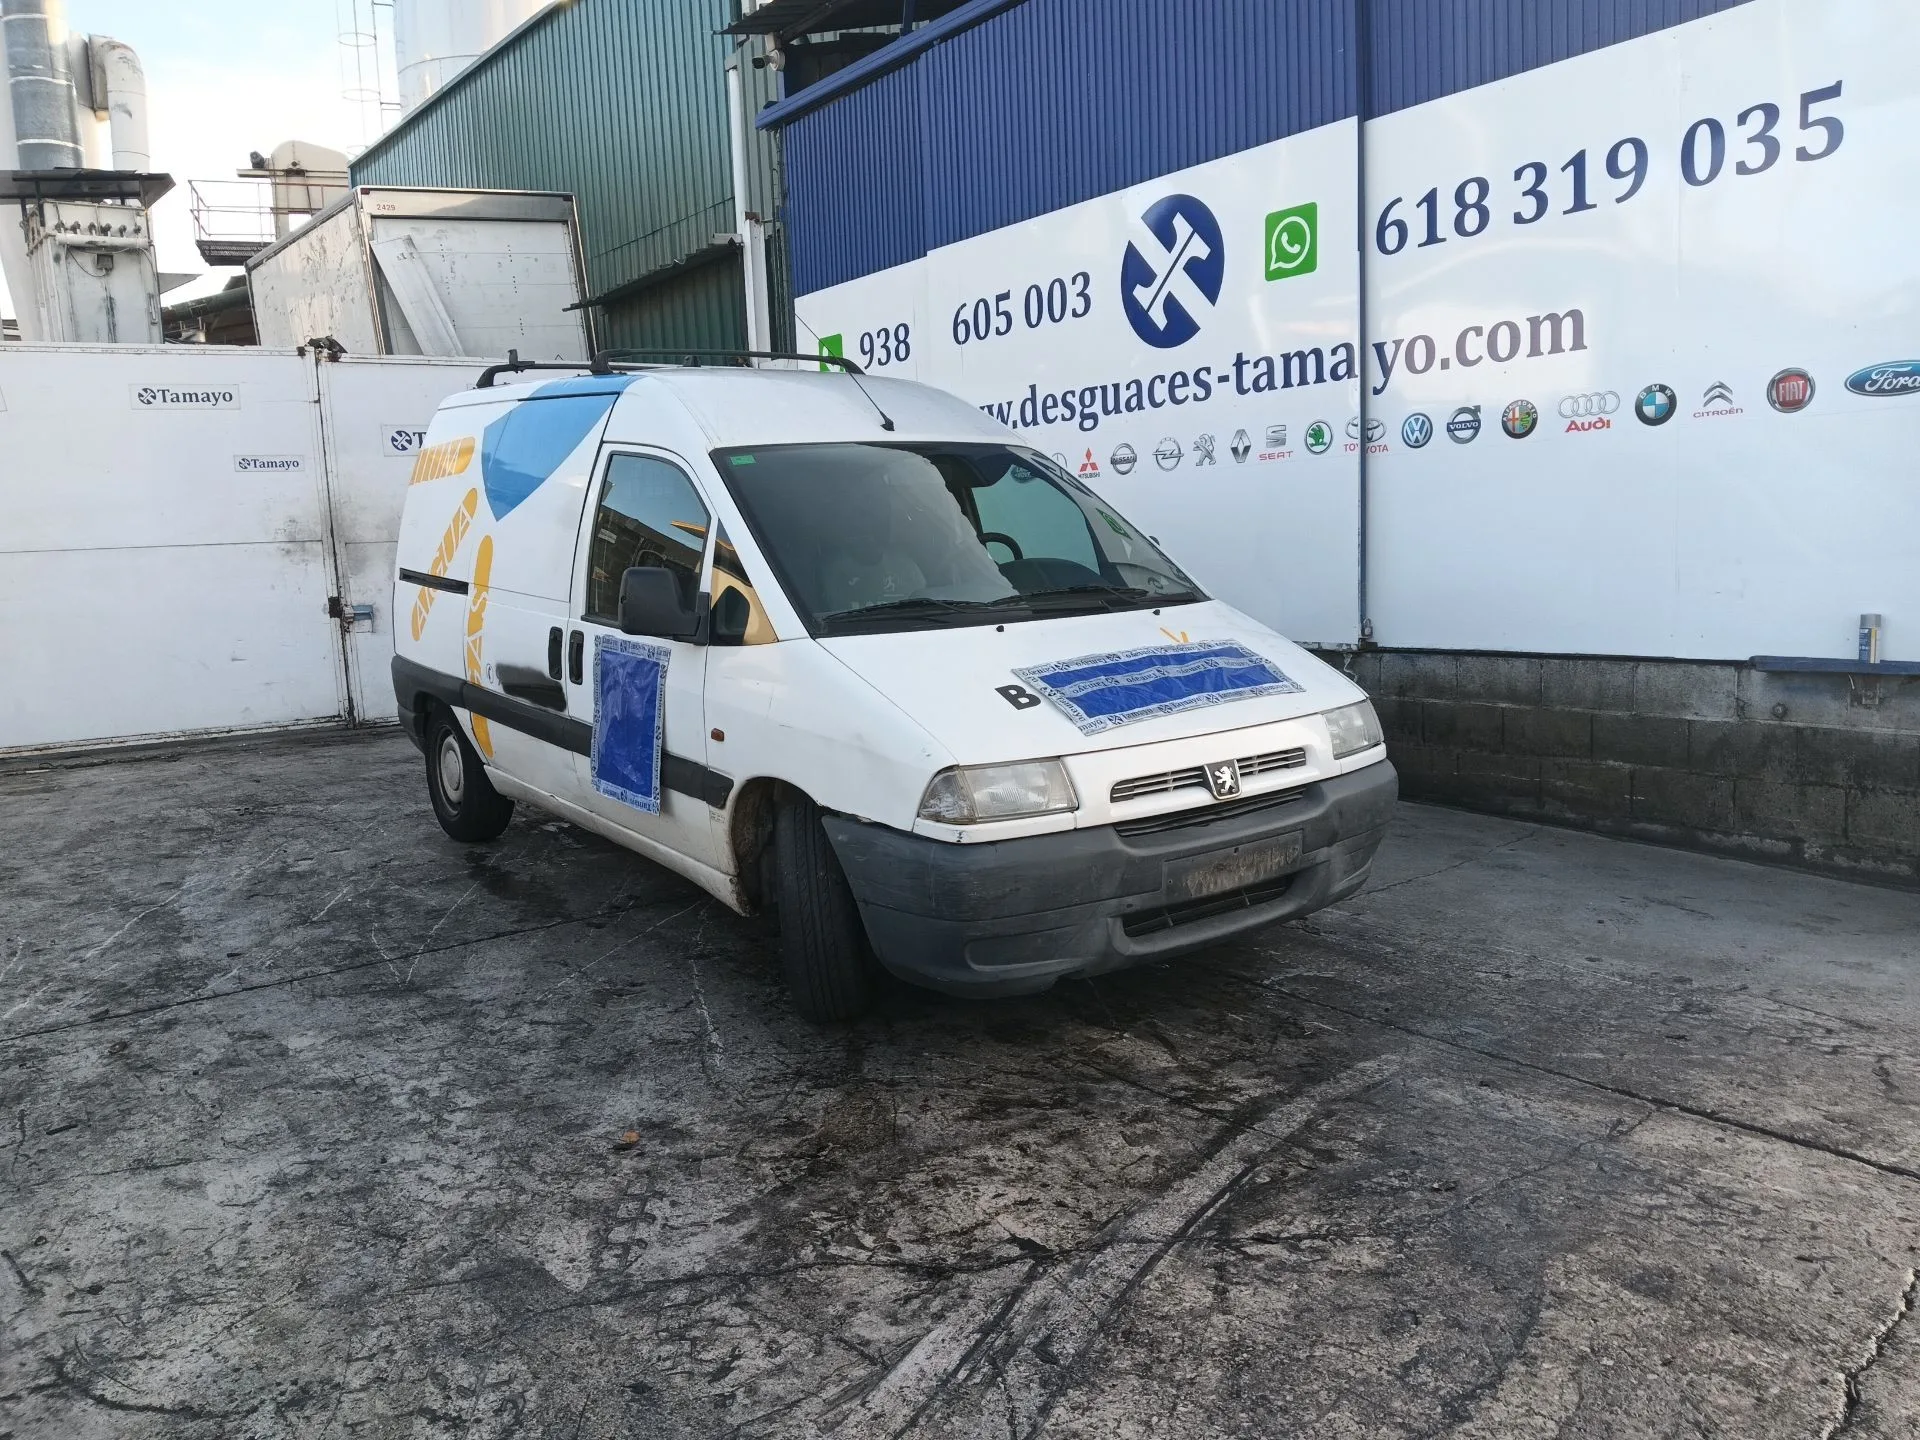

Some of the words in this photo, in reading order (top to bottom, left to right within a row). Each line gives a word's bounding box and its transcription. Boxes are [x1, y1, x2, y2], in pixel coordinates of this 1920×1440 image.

[1376, 175, 1490, 256] 618
[1513, 136, 1648, 225] 319
[1681, 80, 1844, 188] 035
[859, 322, 911, 370] 938
[952, 289, 1012, 346] 605
[1024, 271, 1092, 330] 003
[157, 388, 233, 406] Tamayo
[1778, 380, 1805, 402] FIAT
[1449, 421, 1479, 430] VOLVO
[1565, 417, 1611, 433] Audi
[251, 457, 299, 472] Tamayo
[1259, 450, 1293, 461] SEAT
[995, 684, 1042, 711] B
